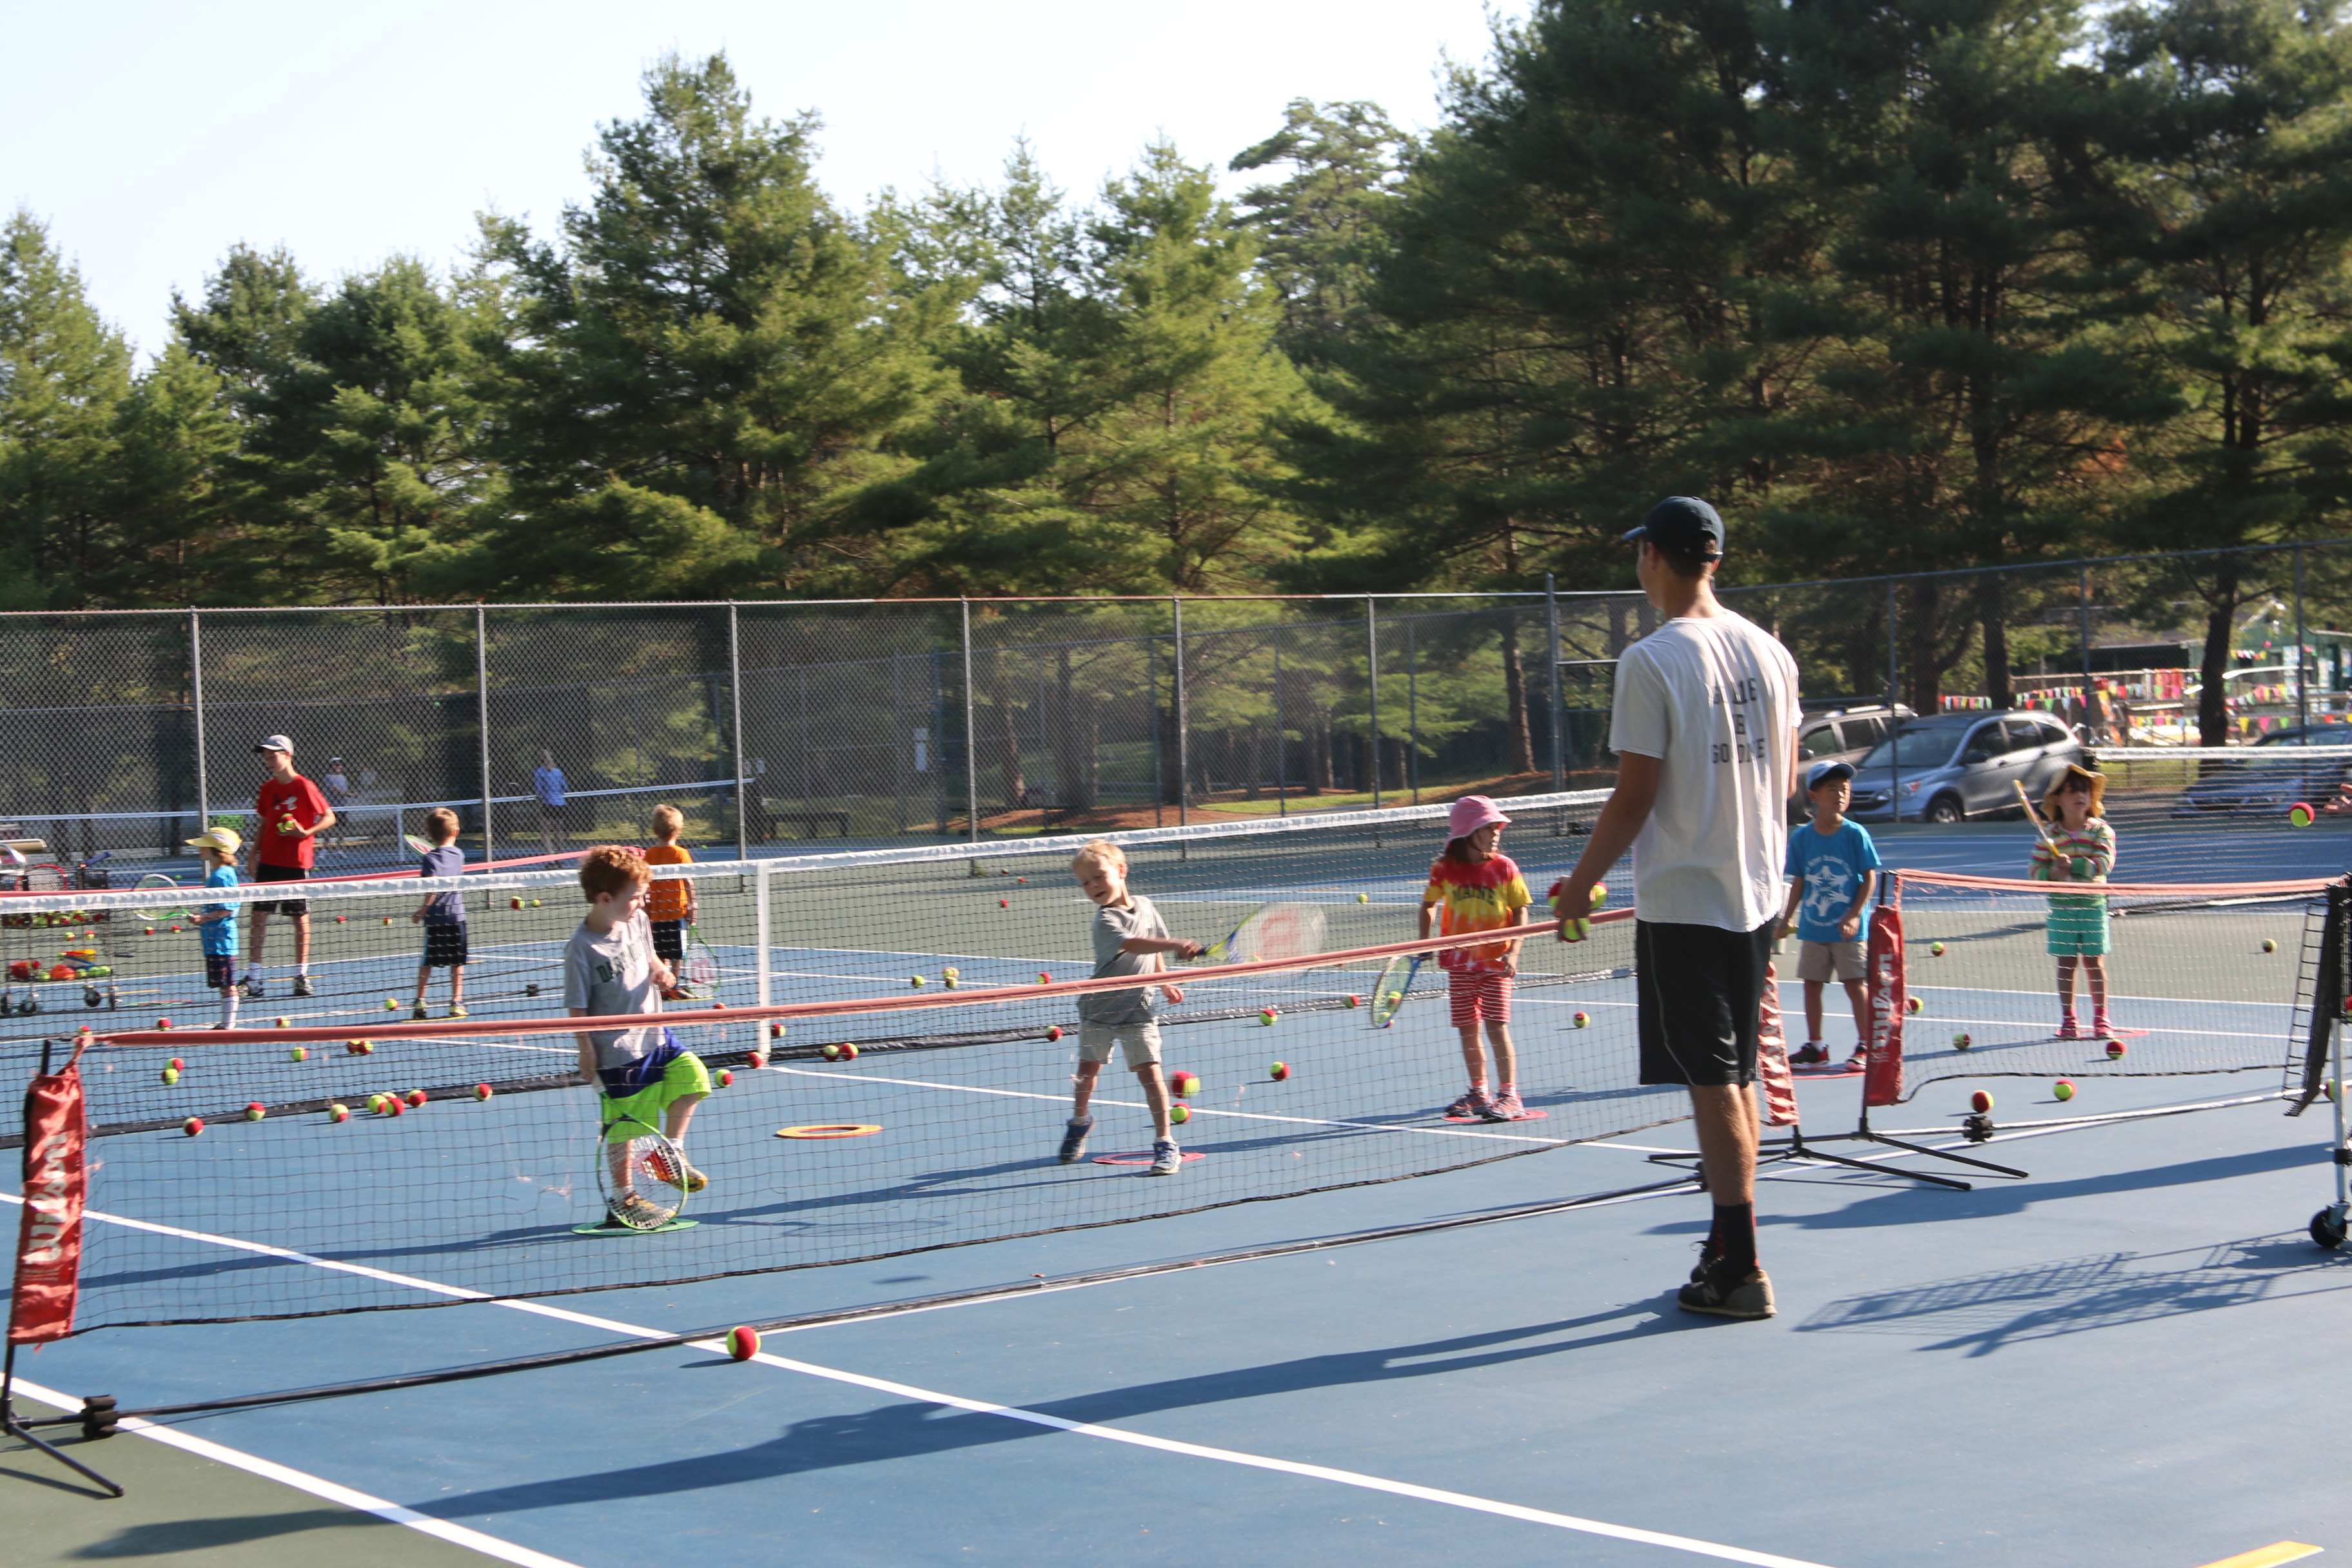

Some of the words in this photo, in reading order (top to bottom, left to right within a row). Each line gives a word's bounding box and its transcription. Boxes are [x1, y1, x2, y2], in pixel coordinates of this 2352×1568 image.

[1453, 883, 1495, 906] MAINE
[1872, 954, 1896, 1050] Wilson
[23, 1132, 68, 1265] Wilson
